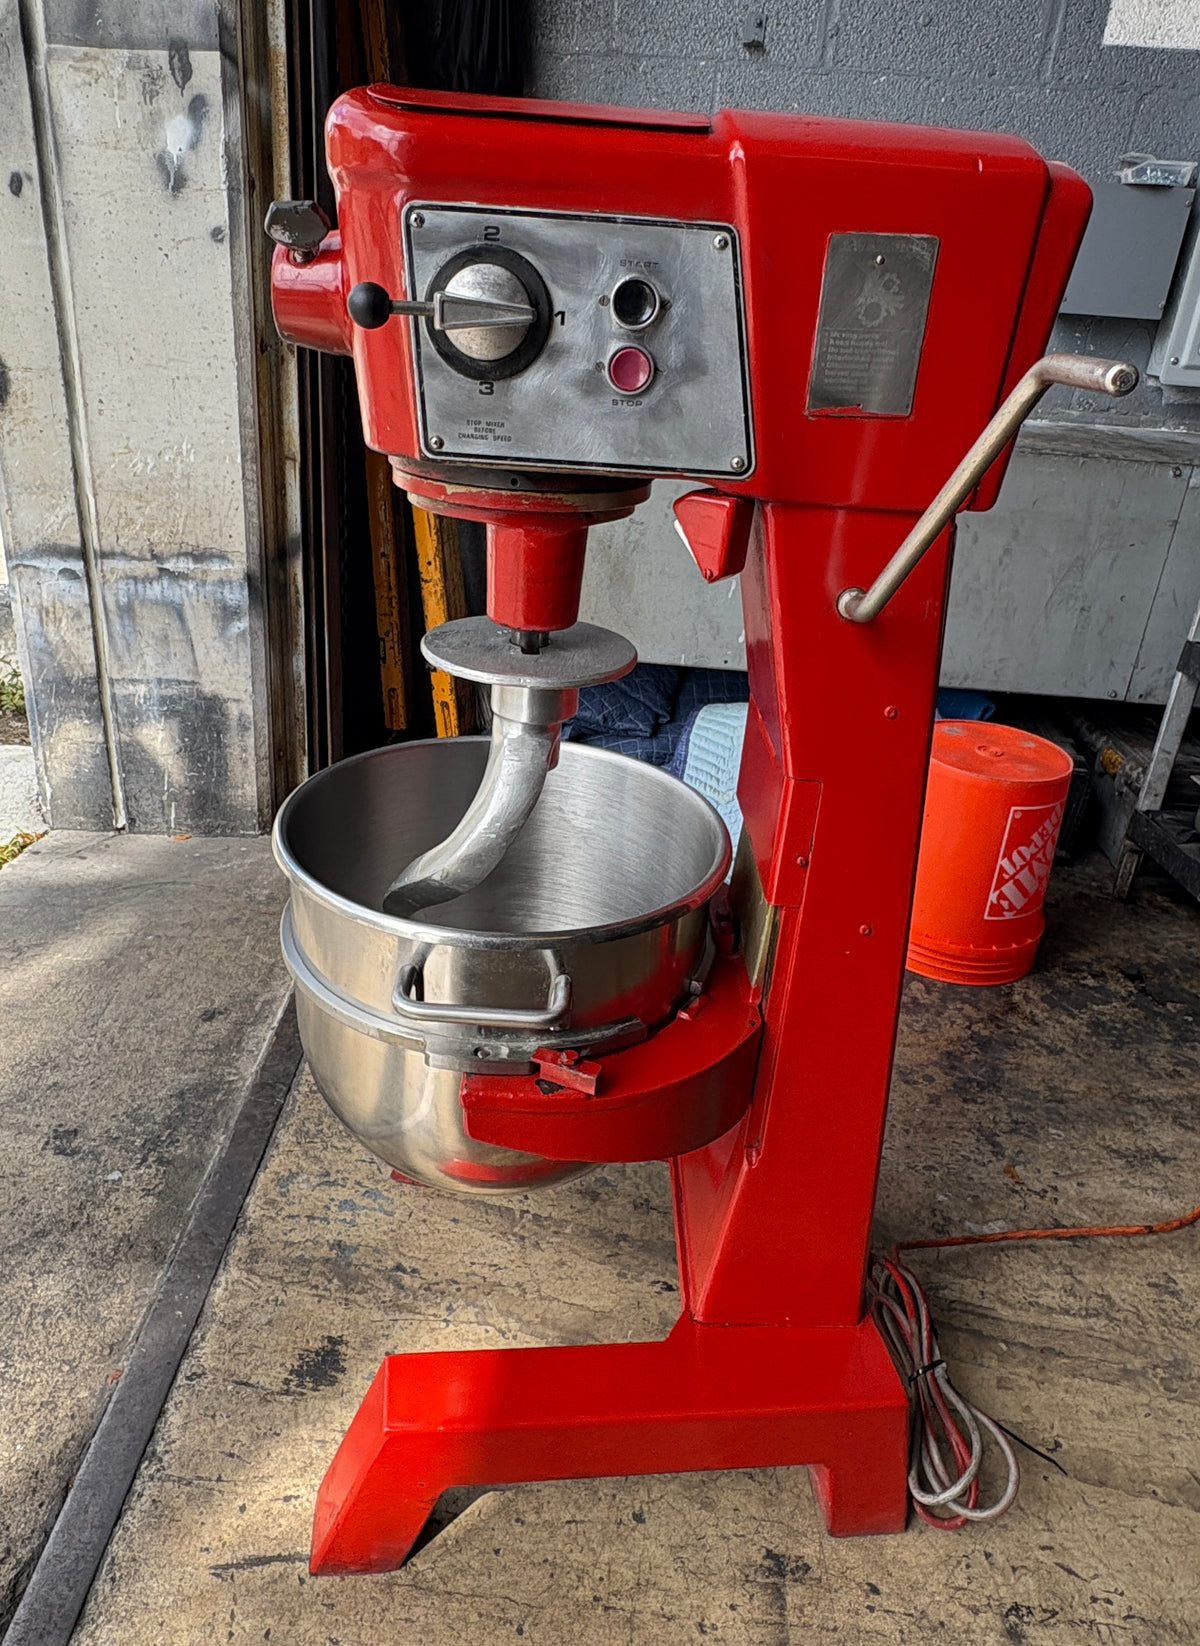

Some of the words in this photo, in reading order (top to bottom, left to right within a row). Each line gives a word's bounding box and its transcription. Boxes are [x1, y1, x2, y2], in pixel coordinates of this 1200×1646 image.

[483, 225, 500, 242] 2
[620, 259, 660, 270] START
[554, 311, 566, 326] 1
[478, 381, 495, 396] 3
[611, 398, 643, 407] STOP
[485, 420, 505, 428] MIXER
[473, 426, 496, 434] BEFORE
[457, 432, 489, 441] CHANGING
[492, 434, 512, 442] SPEED
